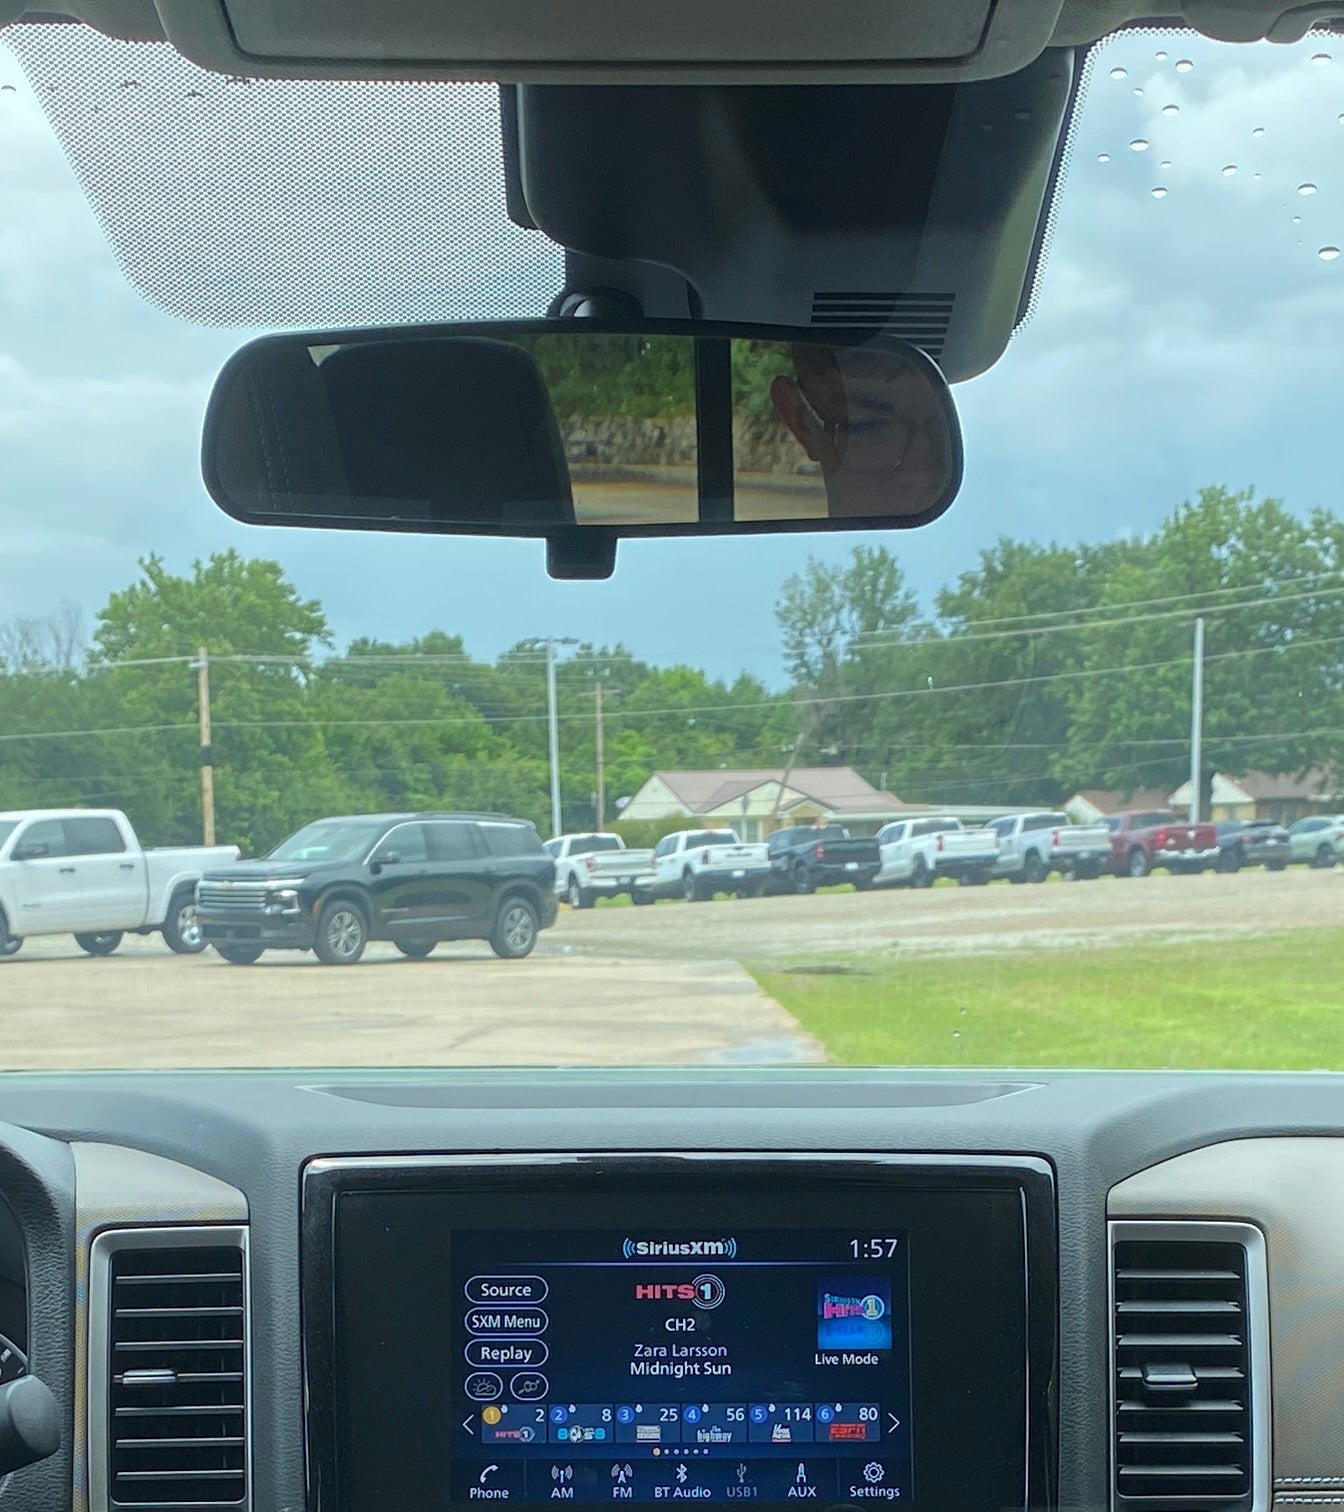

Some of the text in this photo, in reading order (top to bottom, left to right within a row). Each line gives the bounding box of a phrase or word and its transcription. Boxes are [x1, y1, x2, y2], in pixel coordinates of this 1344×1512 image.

[850, 1239, 897, 1258] 1:57
[481, 1283, 532, 1297] Source
[635, 1284, 696, 1300] HITS
[472, 1315, 541, 1329] SXM Menu
[665, 1318, 696, 1332] CH2
[480, 1346, 533, 1363] Replay
[634, 1344, 728, 1358] Zara Larsson
[814, 1353, 879, 1365] Live Mode
[630, 1361, 732, 1379] Midnight Sun
[535, 1408, 545, 1422] 2
[601, 1408, 612, 1422] 8
[659, 1408, 679, 1422] 25
[726, 1407, 745, 1421] 56
[785, 1407, 811, 1421] 114
[859, 1407, 878, 1421] 80
[697, 1429, 732, 1442] highway
[470, 1487, 509, 1499] Phone
[551, 1487, 574, 1498] AM
[613, 1487, 633, 1498] FM
[654, 1486, 711, 1498] BT Audio
[726, 1486, 757, 1497] USB1
[787, 1486, 817, 1497] AUX
[850, 1486, 900, 1500] Settings
